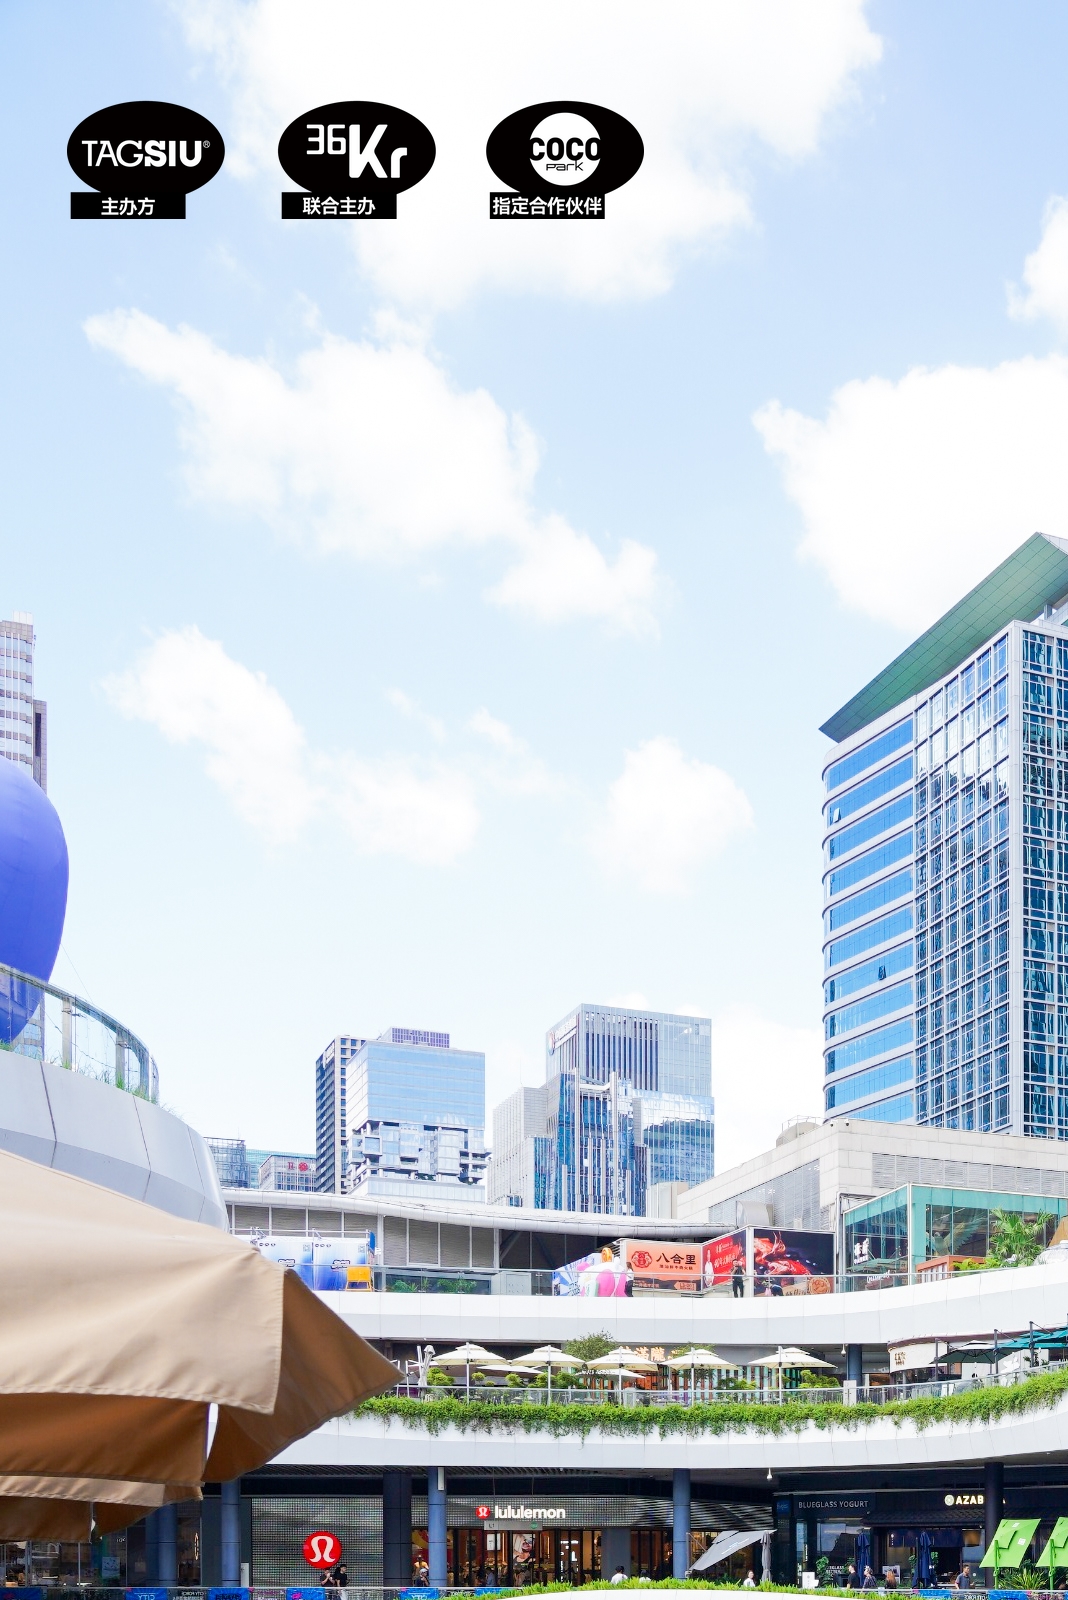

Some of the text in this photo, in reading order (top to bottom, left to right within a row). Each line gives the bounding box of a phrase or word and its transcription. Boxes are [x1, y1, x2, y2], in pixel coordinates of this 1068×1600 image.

[656, 1252, 697, 1265] 八合里
[798, 1500, 869, 1509] BLUEGLASS YOGURT
[494, 1505, 566, 1519] lululemon
